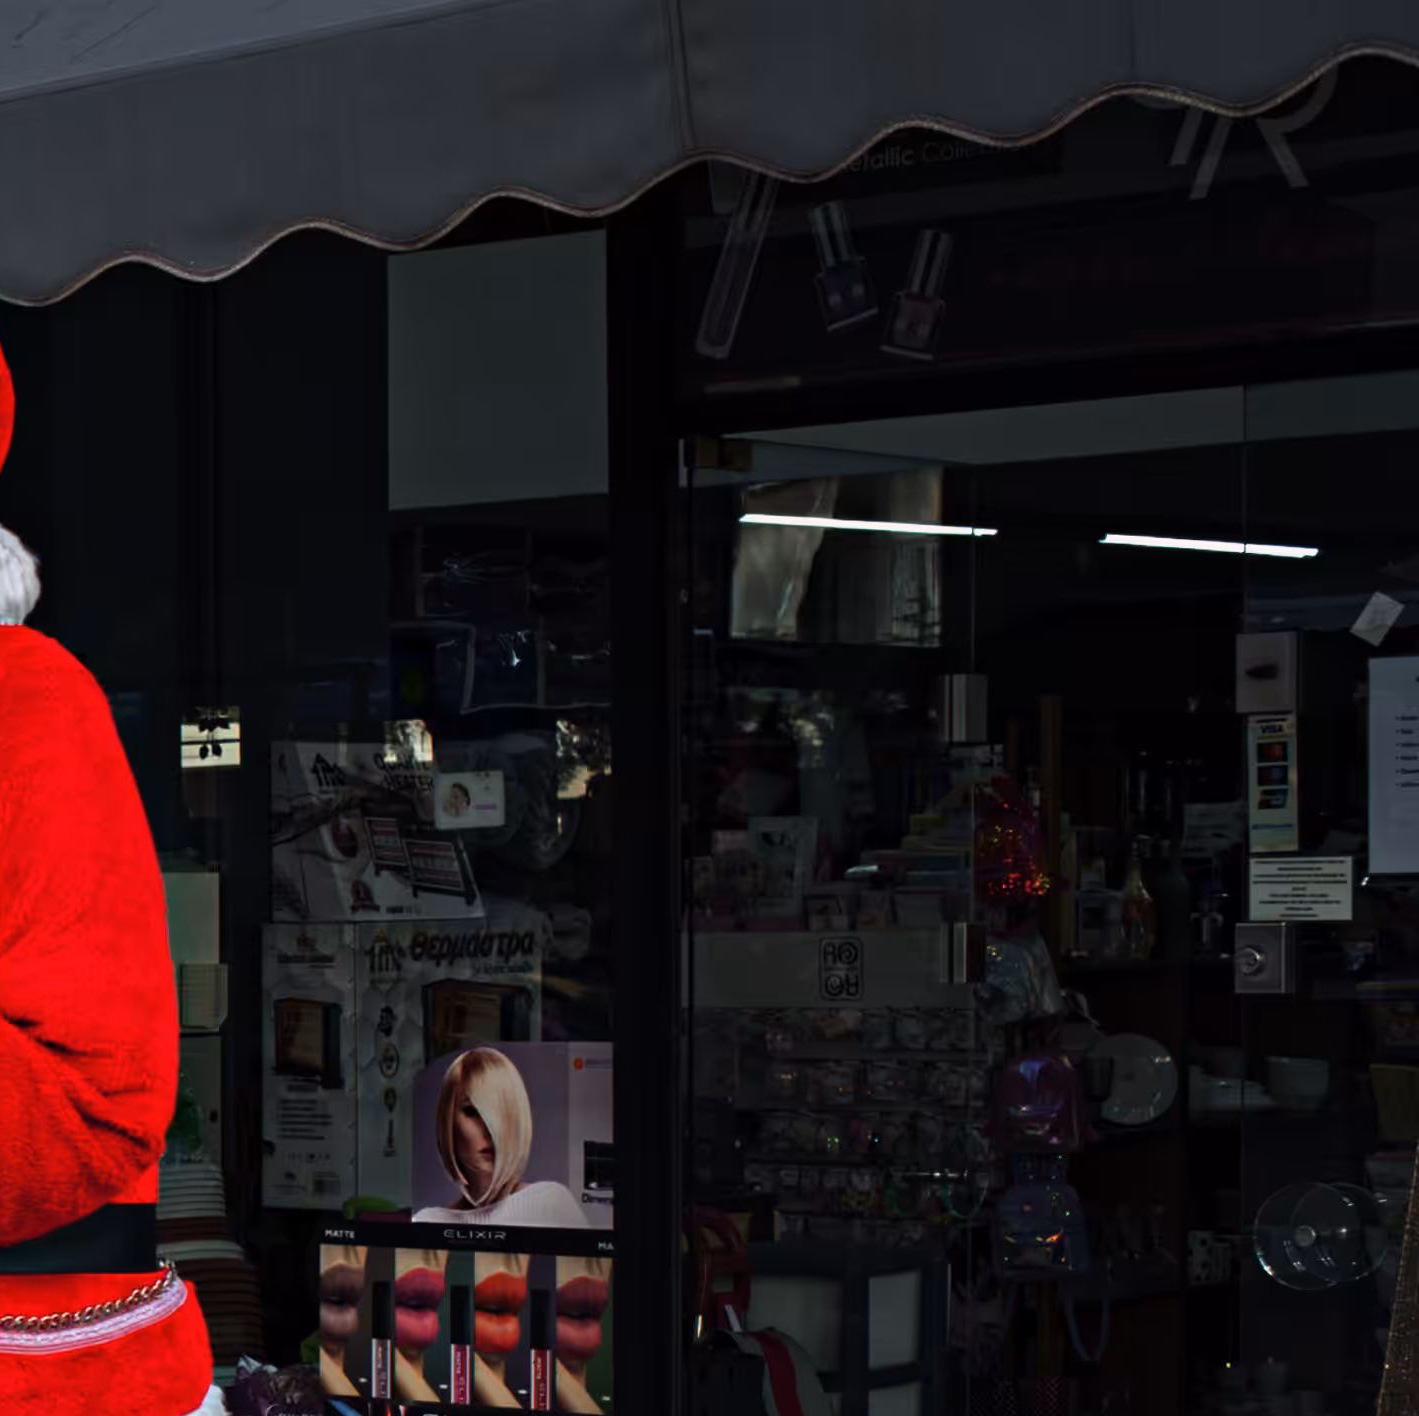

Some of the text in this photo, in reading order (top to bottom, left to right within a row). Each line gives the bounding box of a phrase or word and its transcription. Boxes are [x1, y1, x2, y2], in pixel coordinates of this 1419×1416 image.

[844, 146, 915, 173] etallic
[324, 1228, 356, 1240] MATTE
[442, 1228, 508, 1242] ELIXIR
